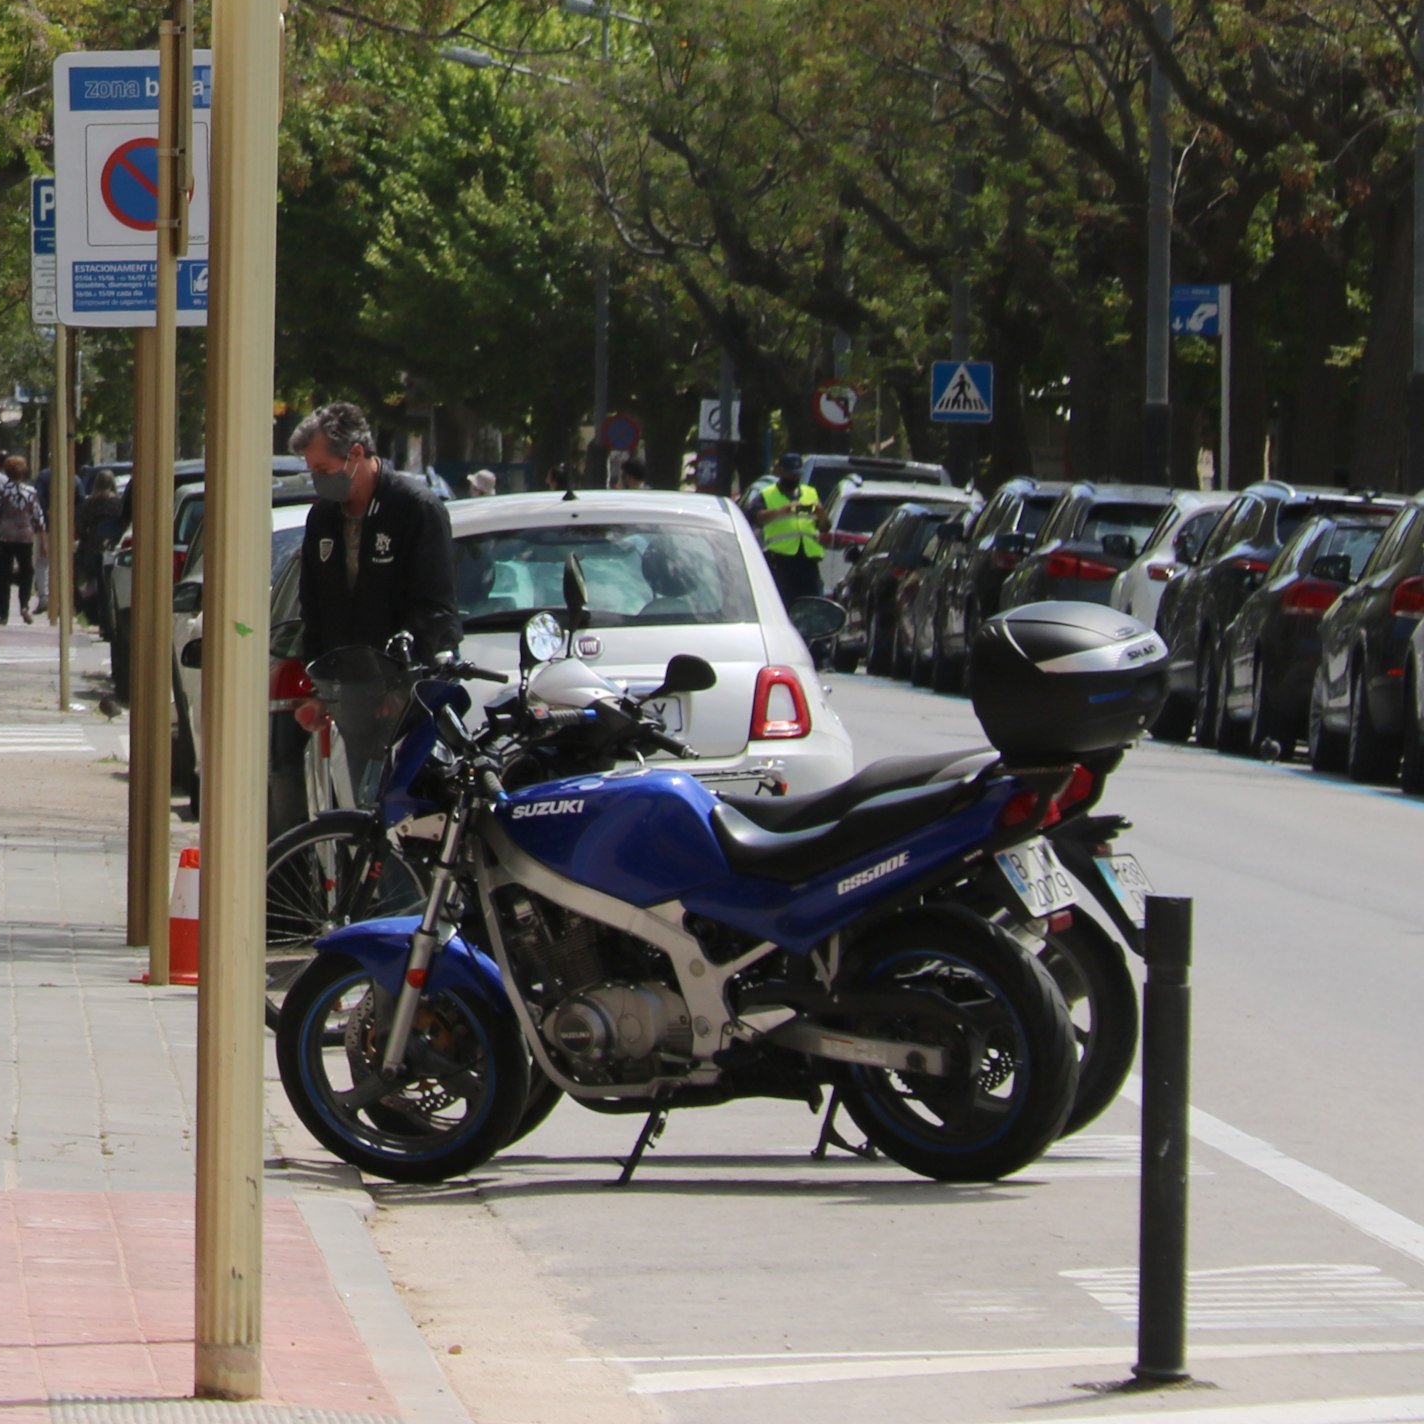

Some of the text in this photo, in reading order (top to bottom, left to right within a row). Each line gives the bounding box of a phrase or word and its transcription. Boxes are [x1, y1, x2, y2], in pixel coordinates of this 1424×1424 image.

[84, 80, 140, 99] zona
[74, 264, 147, 273] ESTACIONAMENT
[580, 641, 598, 654] FIAT
[512, 800, 585, 819] SUZUKI
[837, 850, 910, 896] GS500E
[1010, 854, 1028, 880] B
[1028, 872, 1073, 907] 2079
